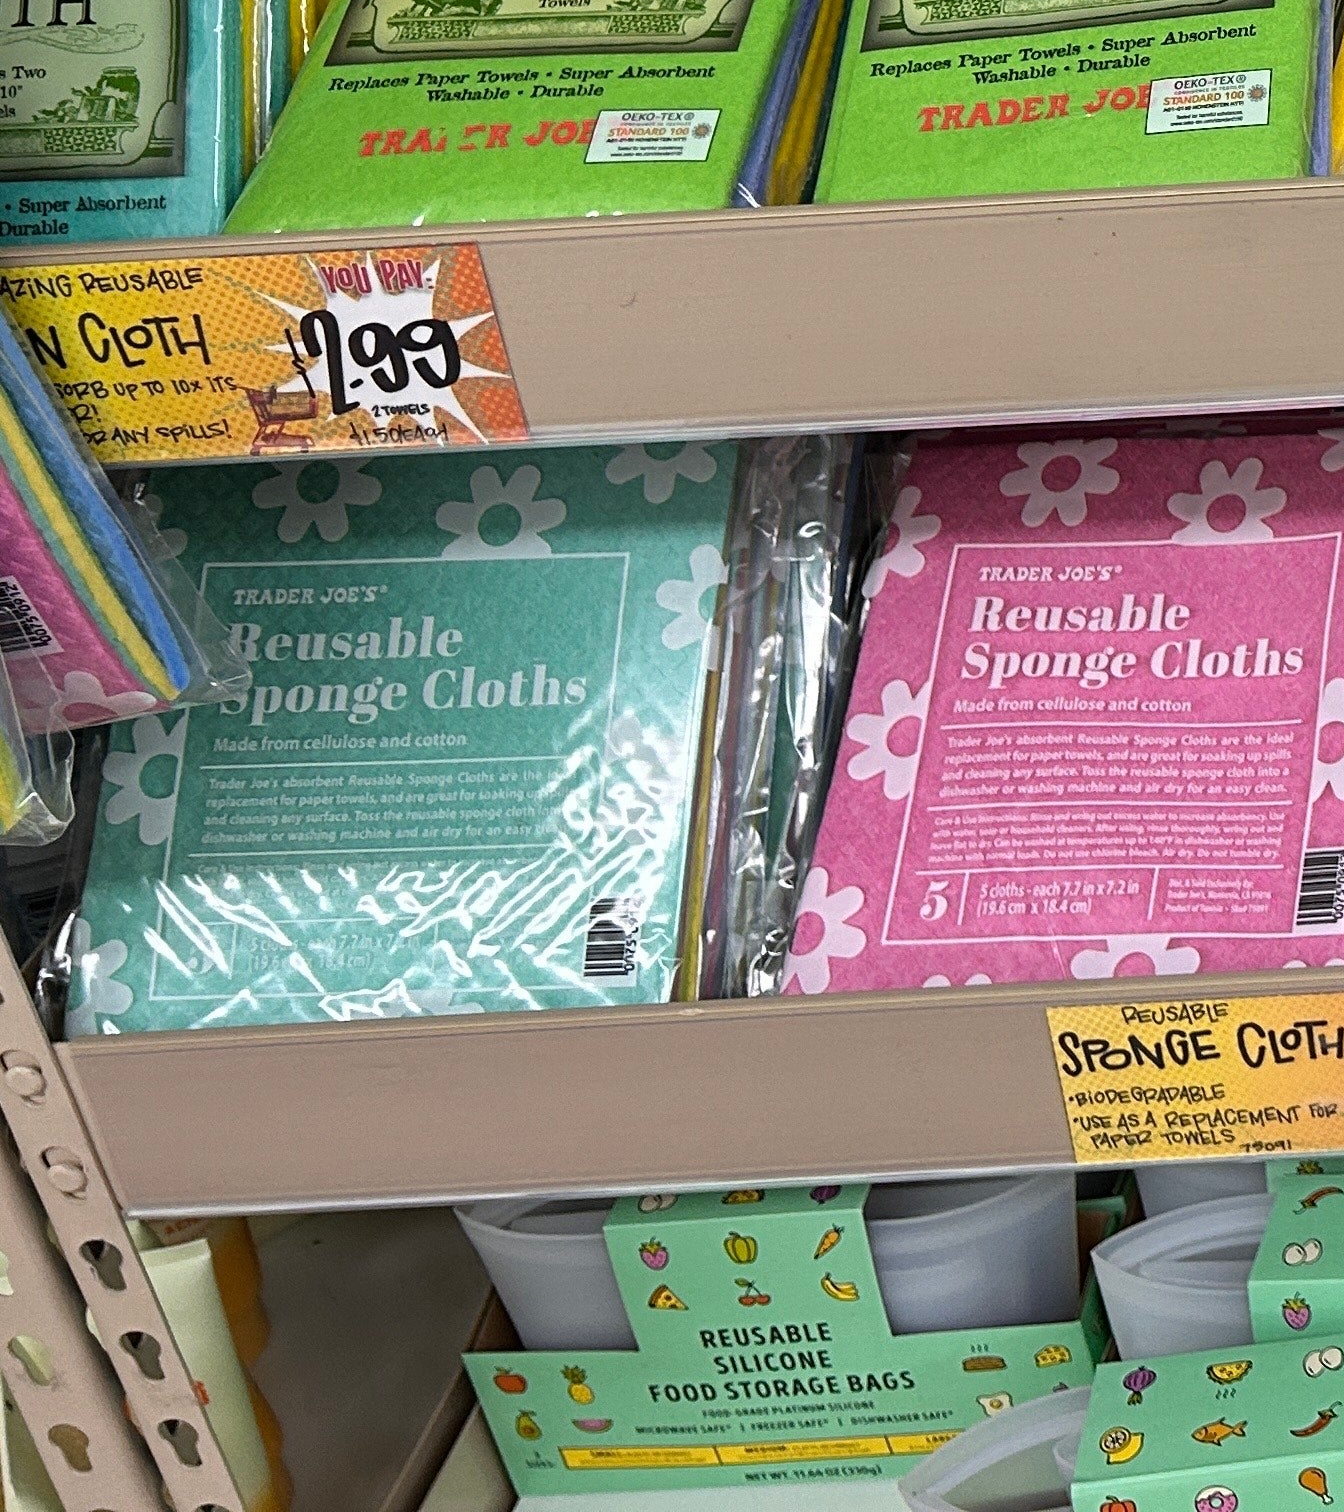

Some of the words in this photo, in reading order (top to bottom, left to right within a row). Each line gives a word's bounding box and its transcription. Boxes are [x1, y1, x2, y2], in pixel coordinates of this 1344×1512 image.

[870, 57, 952, 78] Replaces
[958, 52, 1013, 71] Paper
[1019, 43, 1081, 62] Towels
[1101, 35, 1155, 53] Super
[1160, 24, 1257, 46] Absorbent
[78, 267, 203, 294] REUSABLE
[321, 263, 372, 294] YOU
[78, 312, 211, 368] CLOTH
[285, 310, 460, 415] $2.99
[113, 382, 138, 400] UP
[142, 380, 164, 396] TO
[206, 376, 235, 393] ITS
[111, 427, 149, 447] ANY
[155, 418, 232, 443] SPILLS!
[979, 566, 1053, 582] TRADER
[968, 593, 1191, 633] Reusable
[960, 641, 1137, 690] Sponge
[1150, 638, 1304, 679] Cloths
[1122, 1003, 1229, 1025] REUSABLE
[1059, 1028, 1221, 1078] SPONGE
[1076, 1083, 1225, 1107] BIODEGRADABLE
[1078, 1115, 1111, 1131] USE
[1117, 1113, 1140, 1131] AS
[1145, 1111, 1157, 1128] A
[1165, 1105, 1301, 1129] REPLACEMENT
[1309, 1103, 1338, 1118] FOR
[1090, 1130, 1151, 1149] PAPER
[1160, 1128, 1235, 1146] TOWELS
[700, 1322, 833, 1349] REUSABLE
[713, 1349, 833, 1375] SILICONE
[647, 1382, 717, 1404] FOOD
[727, 1374, 840, 1401] STORAGE
[846, 1370, 915, 1393] BAGS
